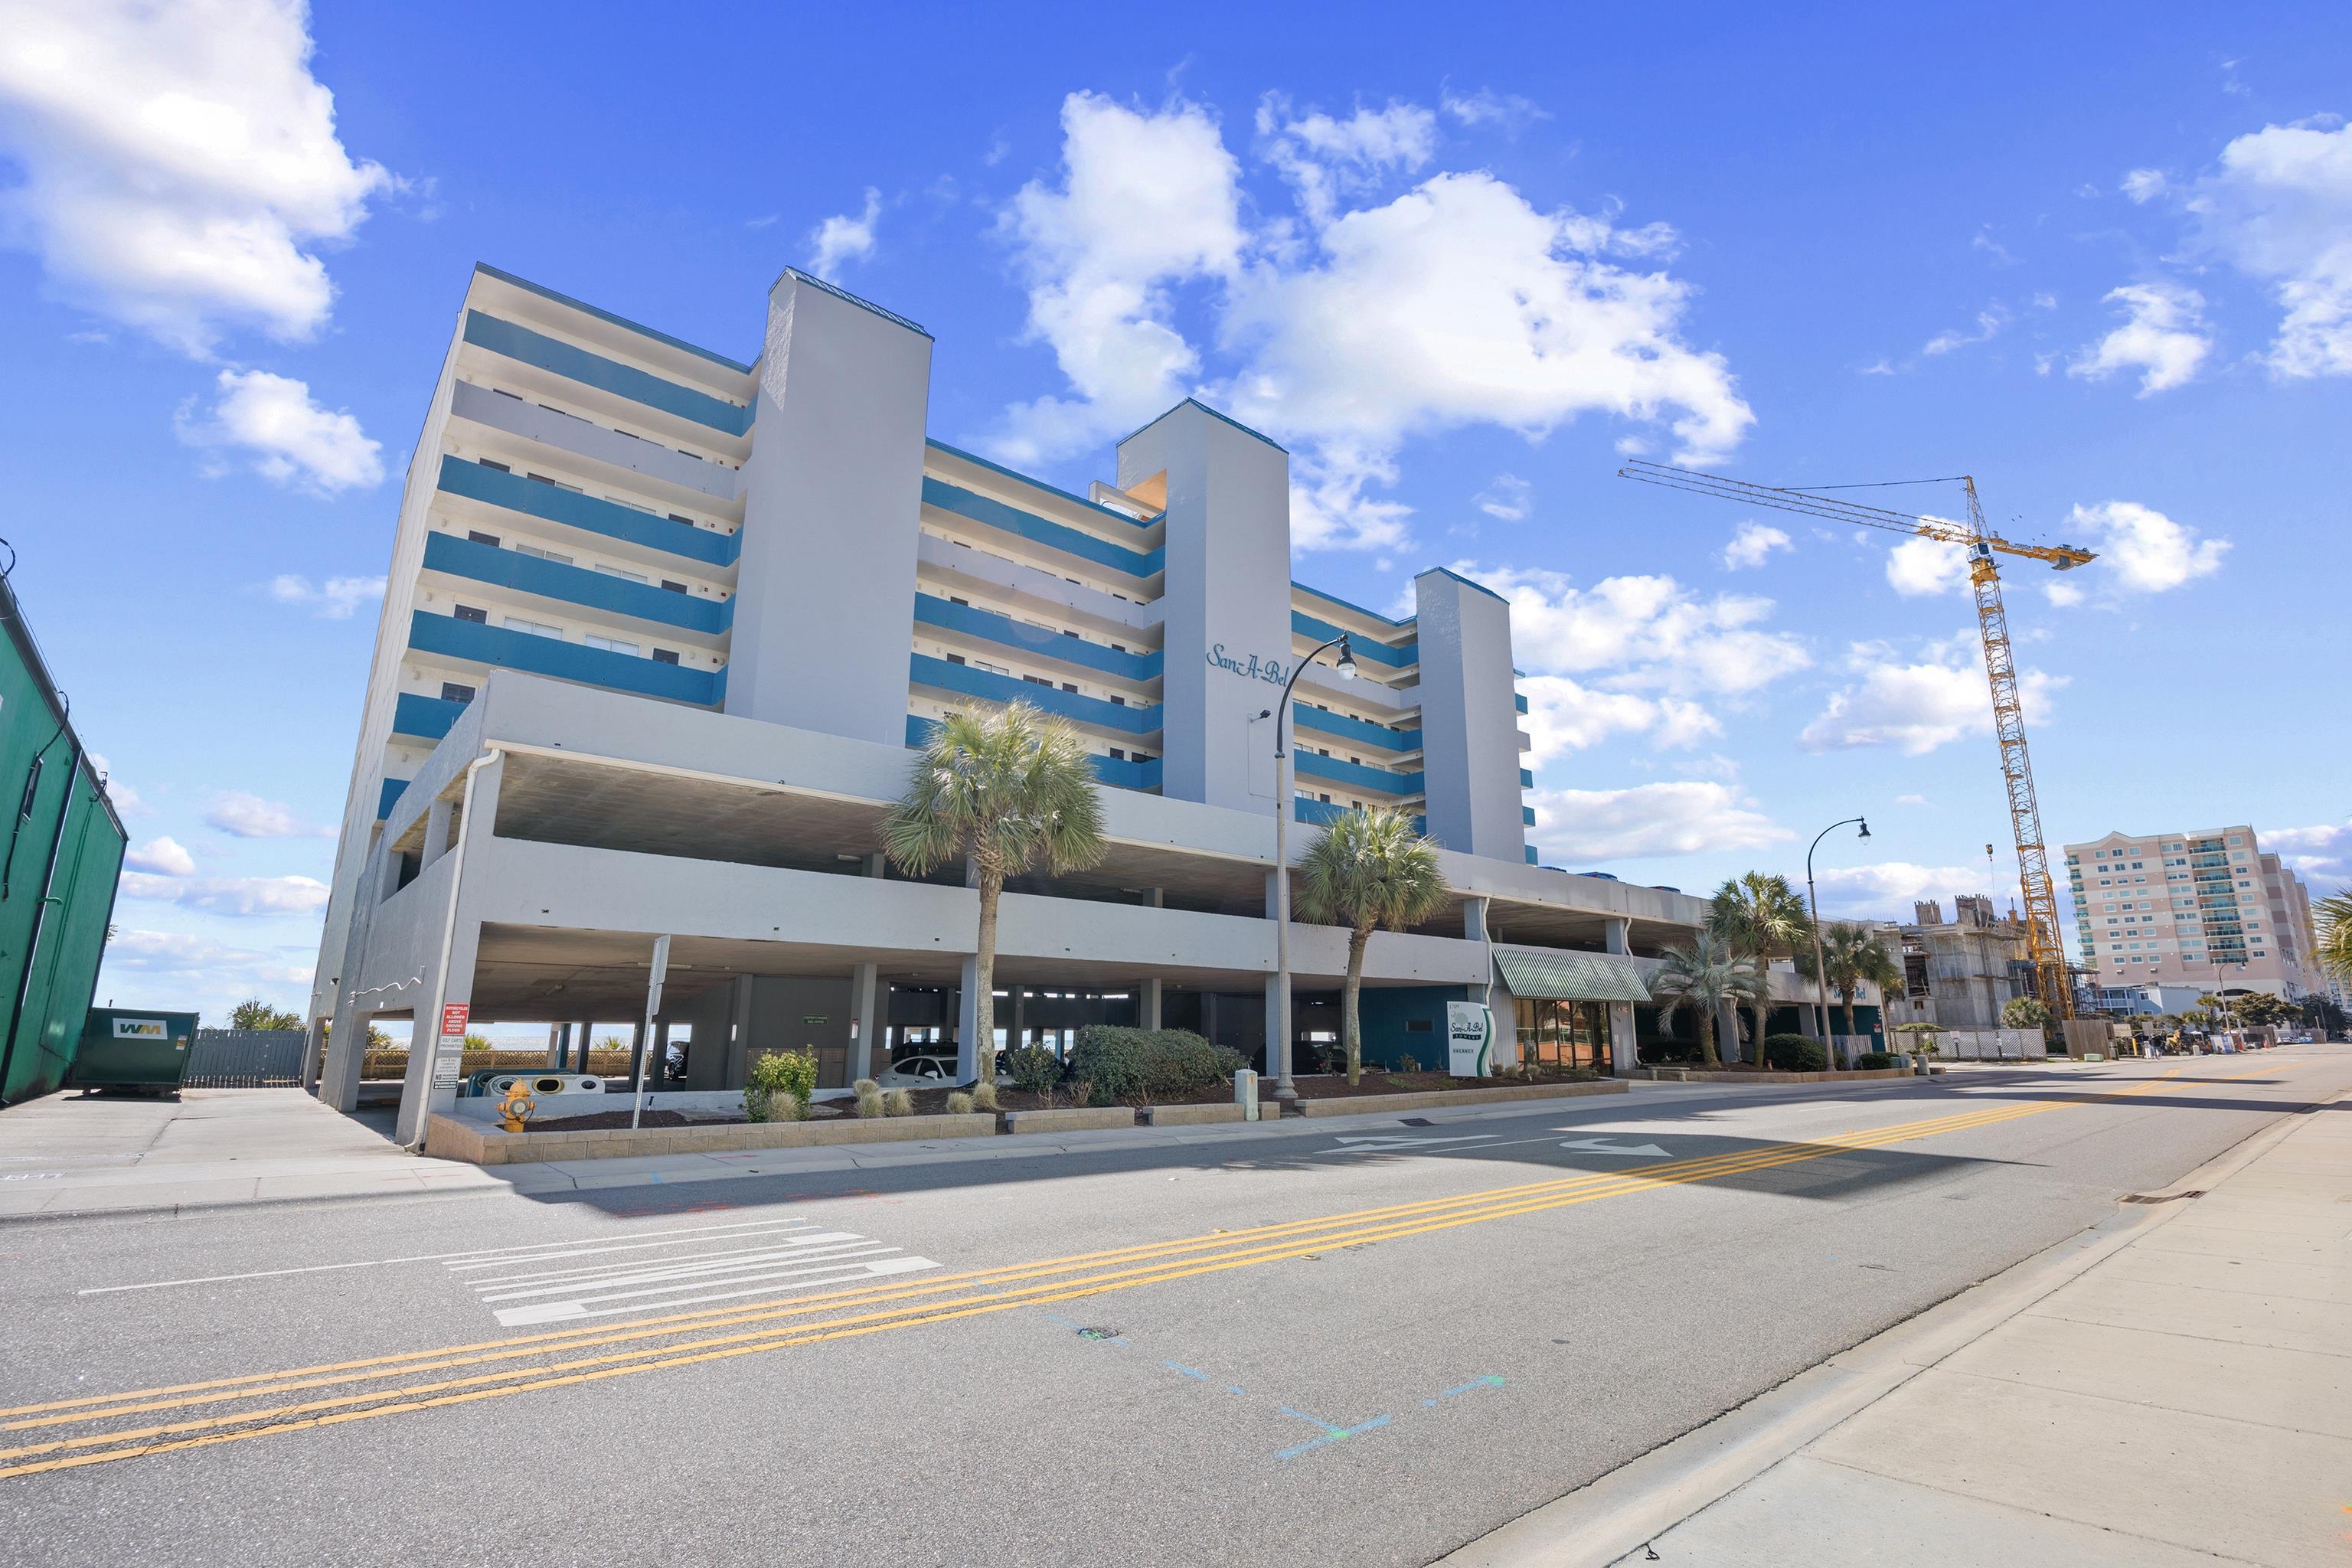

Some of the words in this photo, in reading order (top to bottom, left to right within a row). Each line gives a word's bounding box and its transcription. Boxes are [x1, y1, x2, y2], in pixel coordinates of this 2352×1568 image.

[1206, 643, 1289, 687] San-A-Bel
[119, 1024, 161, 1035] WM
[1450, 1022, 1484, 1032] San-A-Bel
